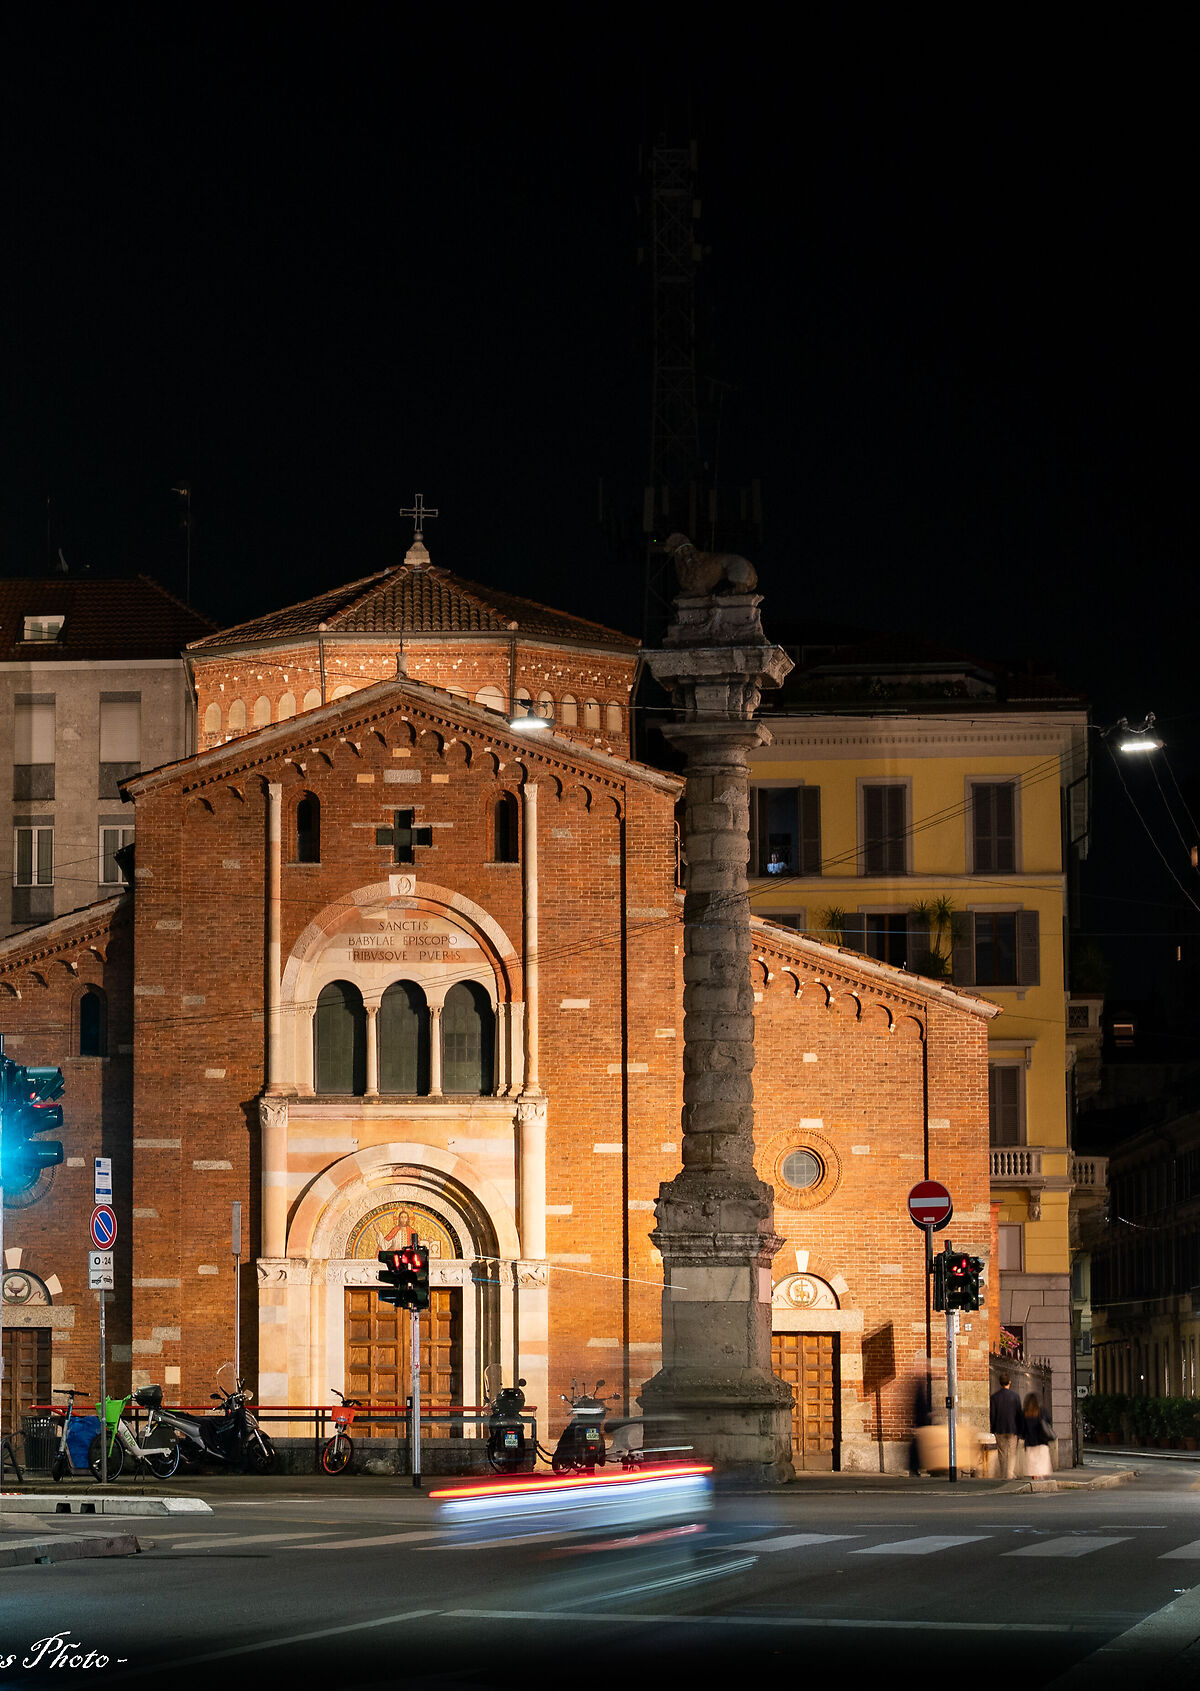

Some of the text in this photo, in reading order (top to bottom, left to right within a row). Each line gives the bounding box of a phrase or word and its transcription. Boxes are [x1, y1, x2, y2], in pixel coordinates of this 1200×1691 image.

[378, 921, 429, 931] SANCTIS
[348, 935, 458, 946] BABYLAE EPISCOPO
[419, 950, 461, 961] PVERIS
